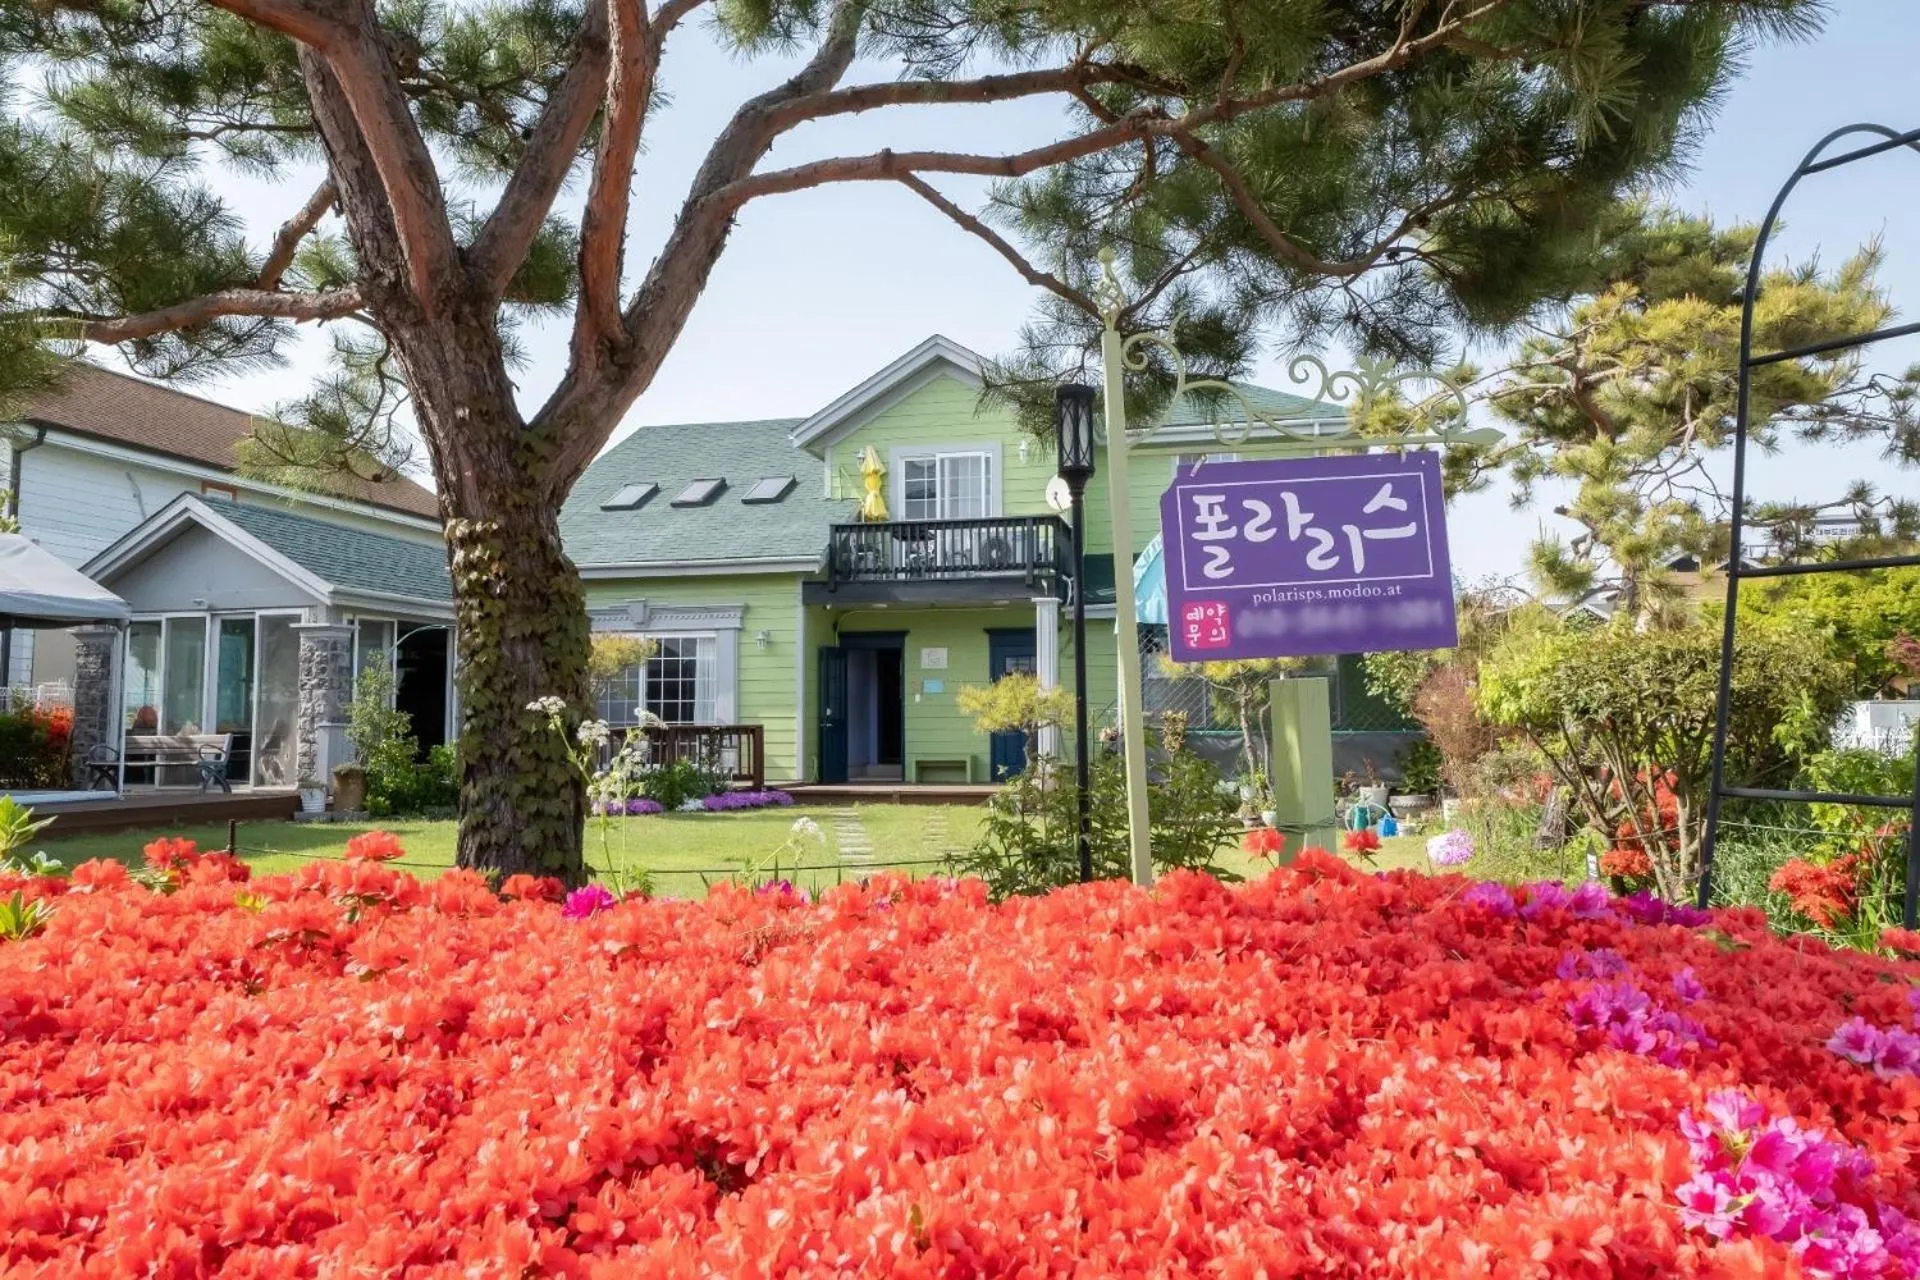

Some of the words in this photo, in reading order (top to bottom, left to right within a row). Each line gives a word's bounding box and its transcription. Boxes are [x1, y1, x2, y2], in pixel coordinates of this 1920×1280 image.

[1192, 483, 1417, 579] 폴라리스
[1252, 585, 1402, 606] polarisps.modoo.at
[1187, 603, 1228, 626] 예약
[1187, 624, 1227, 648] 문의
